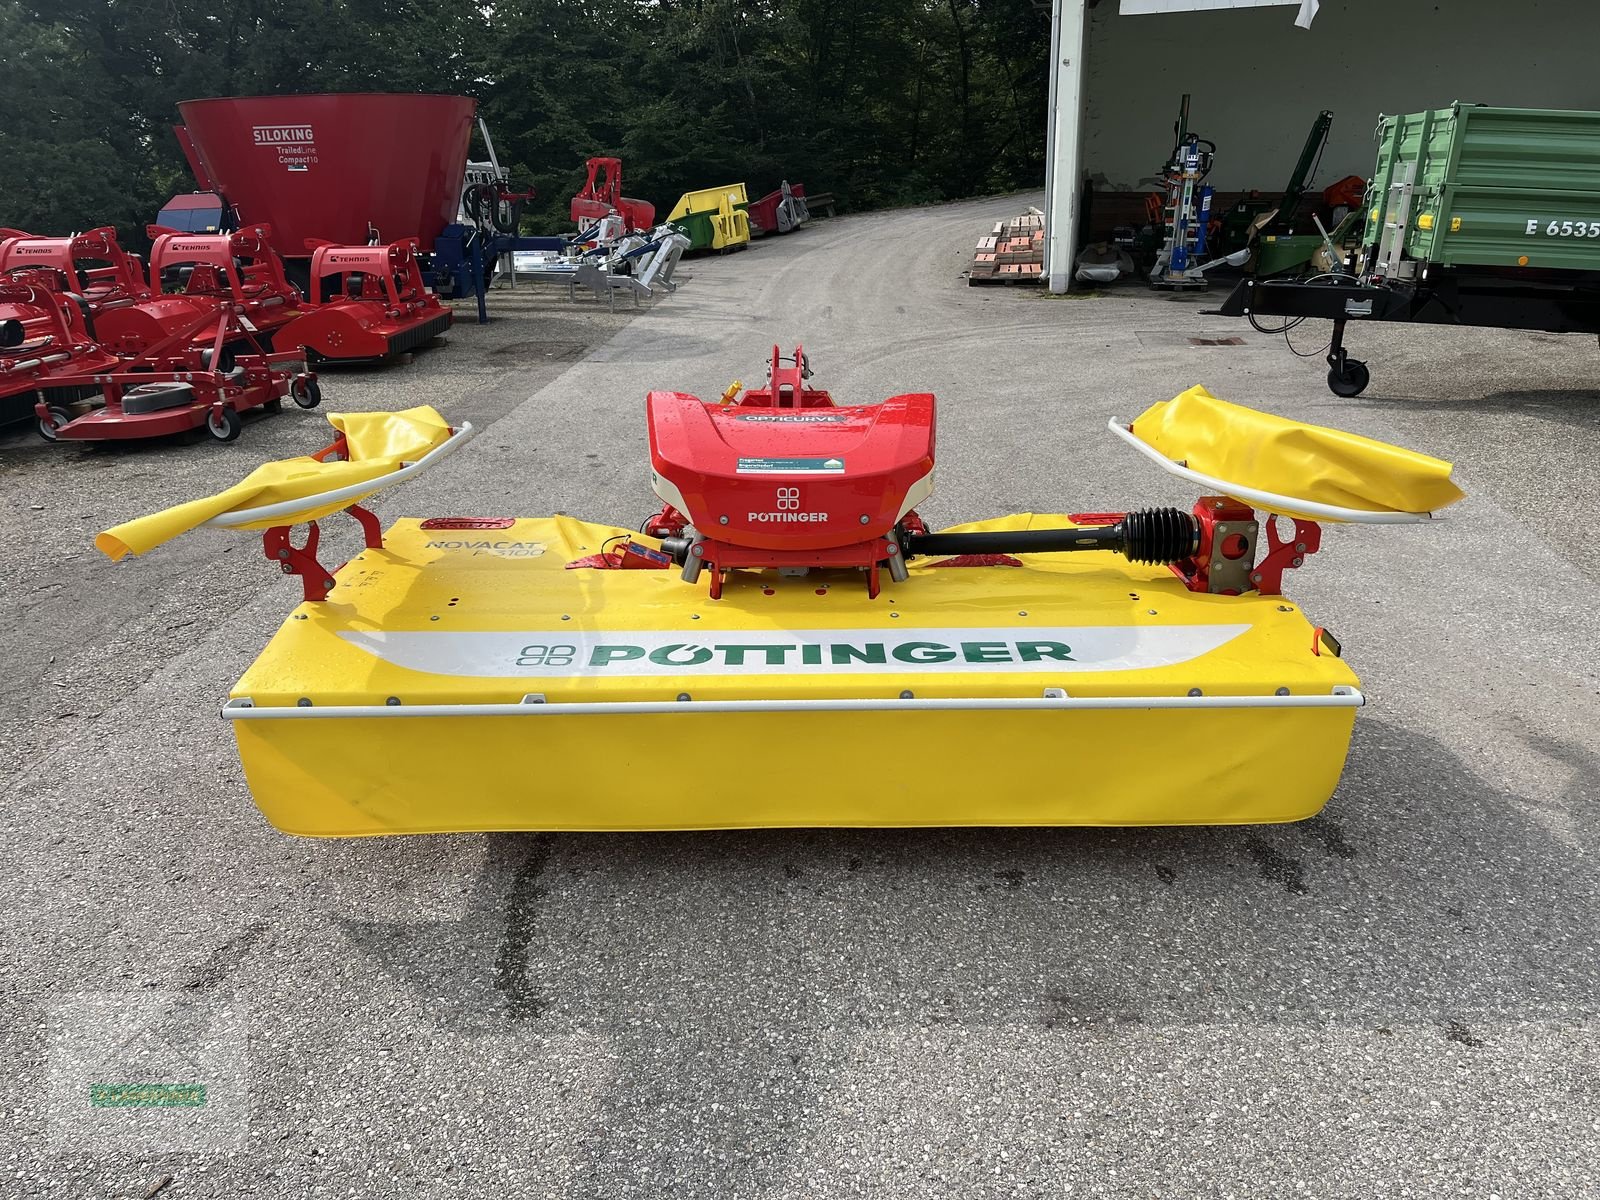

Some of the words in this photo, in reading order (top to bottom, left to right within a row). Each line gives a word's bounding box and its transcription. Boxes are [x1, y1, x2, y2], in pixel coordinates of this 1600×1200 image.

[253, 129, 314, 142] SILOKING
[1525, 219, 1539, 235] E
[1546, 220, 1600, 239] 6535
[424, 541, 542, 549] NOVACAT
[588, 640, 1077, 667] PÖTTINGER
